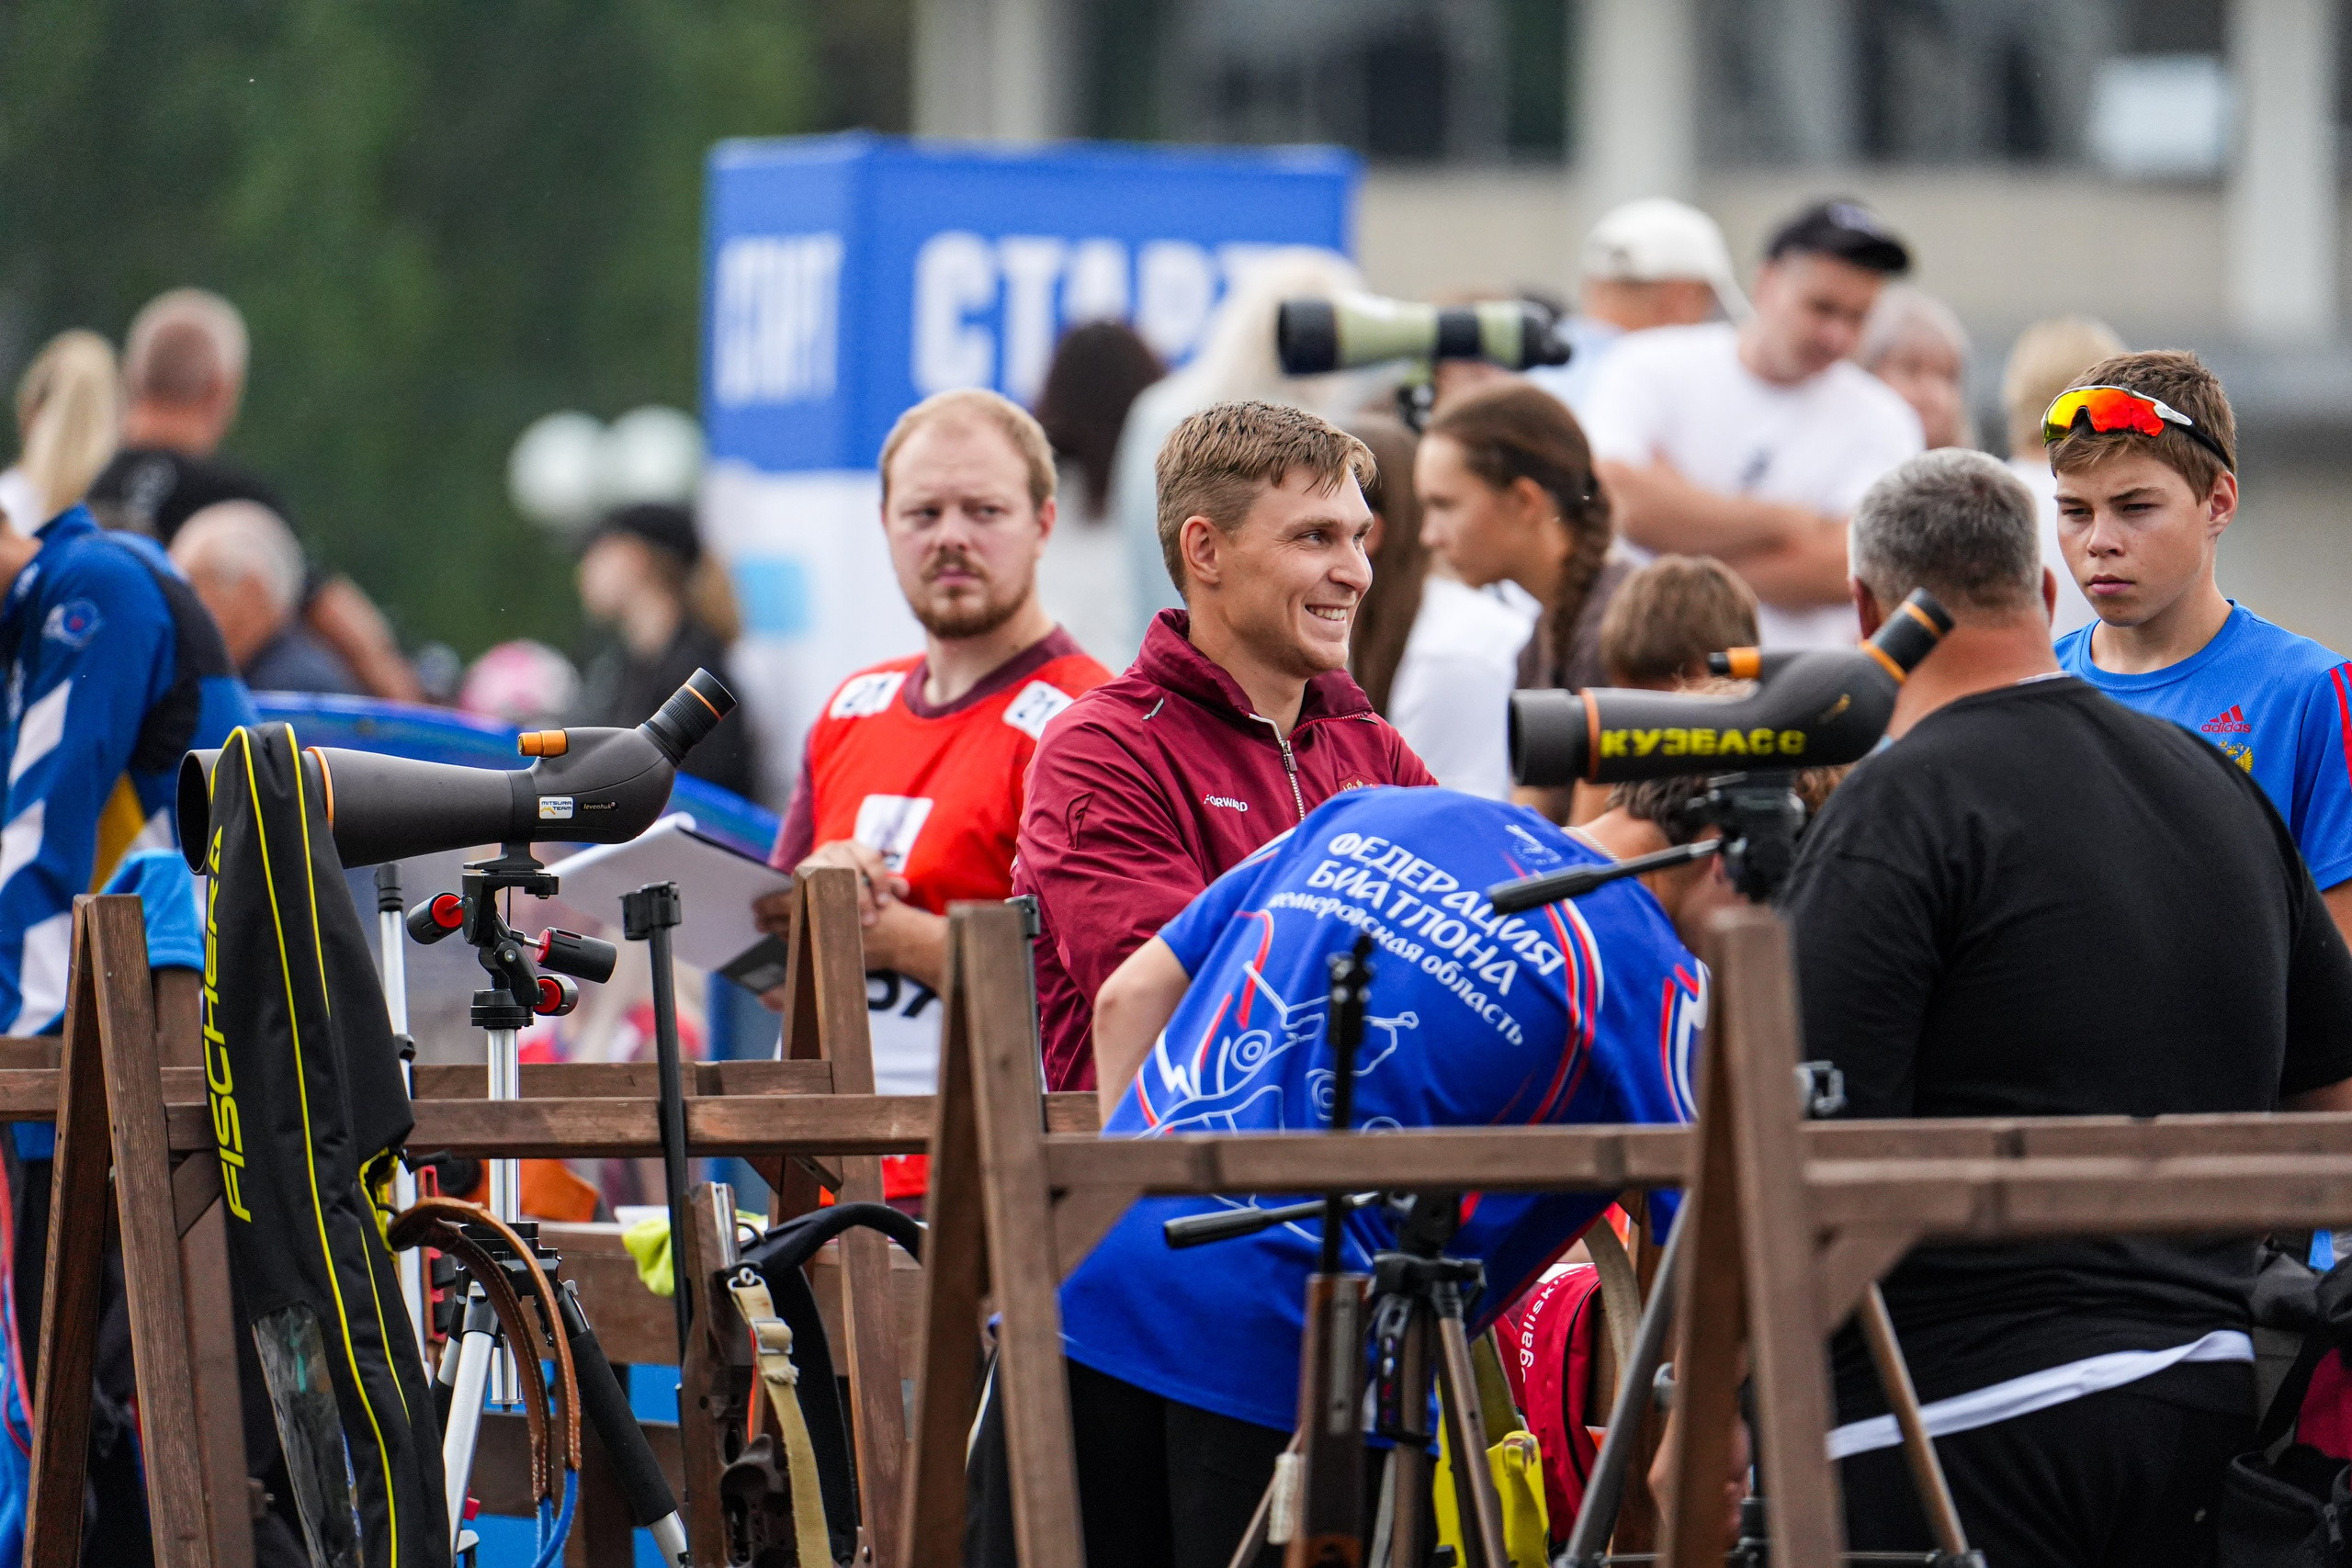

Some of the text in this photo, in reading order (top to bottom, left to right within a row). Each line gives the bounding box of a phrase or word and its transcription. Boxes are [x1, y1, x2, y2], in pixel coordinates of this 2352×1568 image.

[1600, 728, 1807, 759] КУЗБАСС
[2201, 721, 2251, 733] adidas
[582, 802, 612, 810] levenhuk
[1204, 793, 1249, 813] FORWARD
[1306, 859, 1519, 997] БИАТЛОНА
[1328, 831, 1565, 976] ФЕДЕРАЦИЯ
[1420, 953, 1525, 1047] область
[203, 876, 253, 1224] FISCHER
